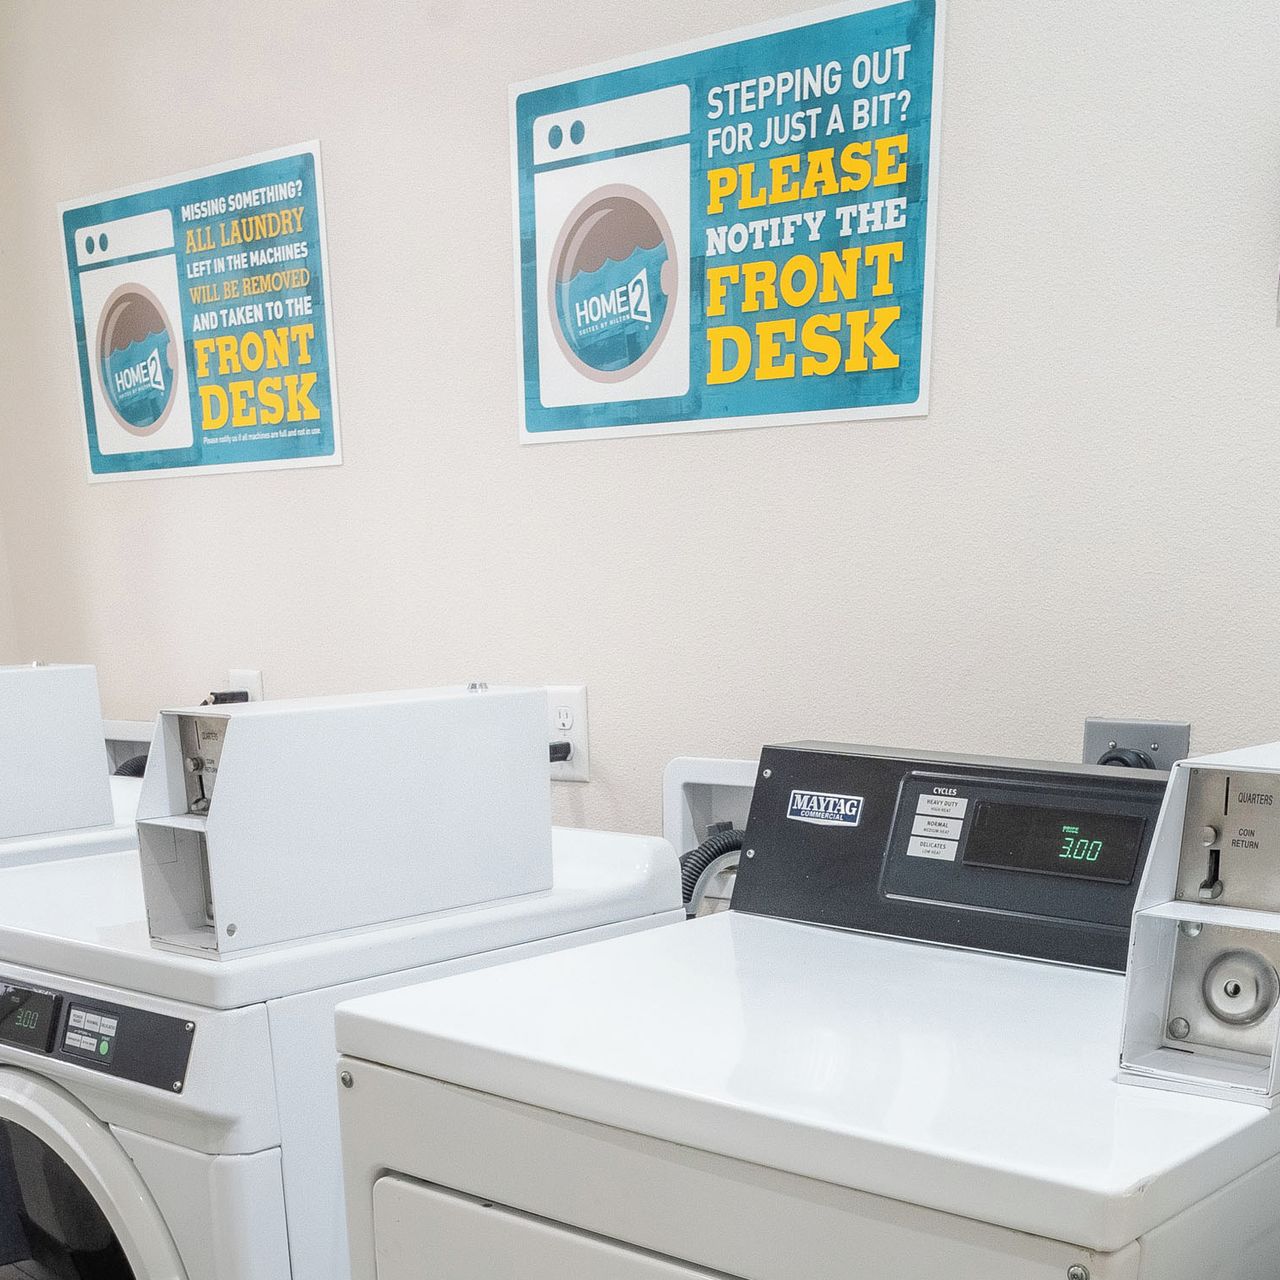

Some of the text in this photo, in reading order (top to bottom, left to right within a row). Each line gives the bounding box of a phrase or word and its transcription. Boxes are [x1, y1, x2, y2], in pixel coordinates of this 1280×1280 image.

[707, 44, 912, 121] STEPPING OUT
[707, 89, 912, 158] FOR JUST A BIT?
[707, 133, 909, 216] PLEASE
[181, 180, 303, 222] MISSING SOMETHING?
[185, 207, 305, 254] ALL LAUNDRY
[706, 196, 907, 257] NOTIFY THE
[187, 241, 308, 279] LEFT IN THE MACHINES
[189, 268, 310, 305] WILL BE REMOVED
[706, 241, 904, 317] FRONT
[192, 296, 313, 332] AND TAKEN TO THE
[194, 323, 314, 378] FRONT
[706, 306, 901, 385] DESK
[198, 372, 321, 430] DESK
[792, 794, 858, 816] MAYTAG
[933, 787, 957, 796] CYCLES
[944, 800, 959, 808] DUTY
[1238, 792, 1273, 806] QUARTERS
[800, 810, 844, 820] COMMERCIAL
[927, 820, 949, 829] NORMAL
[1238, 828, 1255, 838] COIN
[919, 841, 946, 850] DELICATES
[1059, 837, 1103, 861] 3.00
[1231, 839, 1260, 849] RETURN
